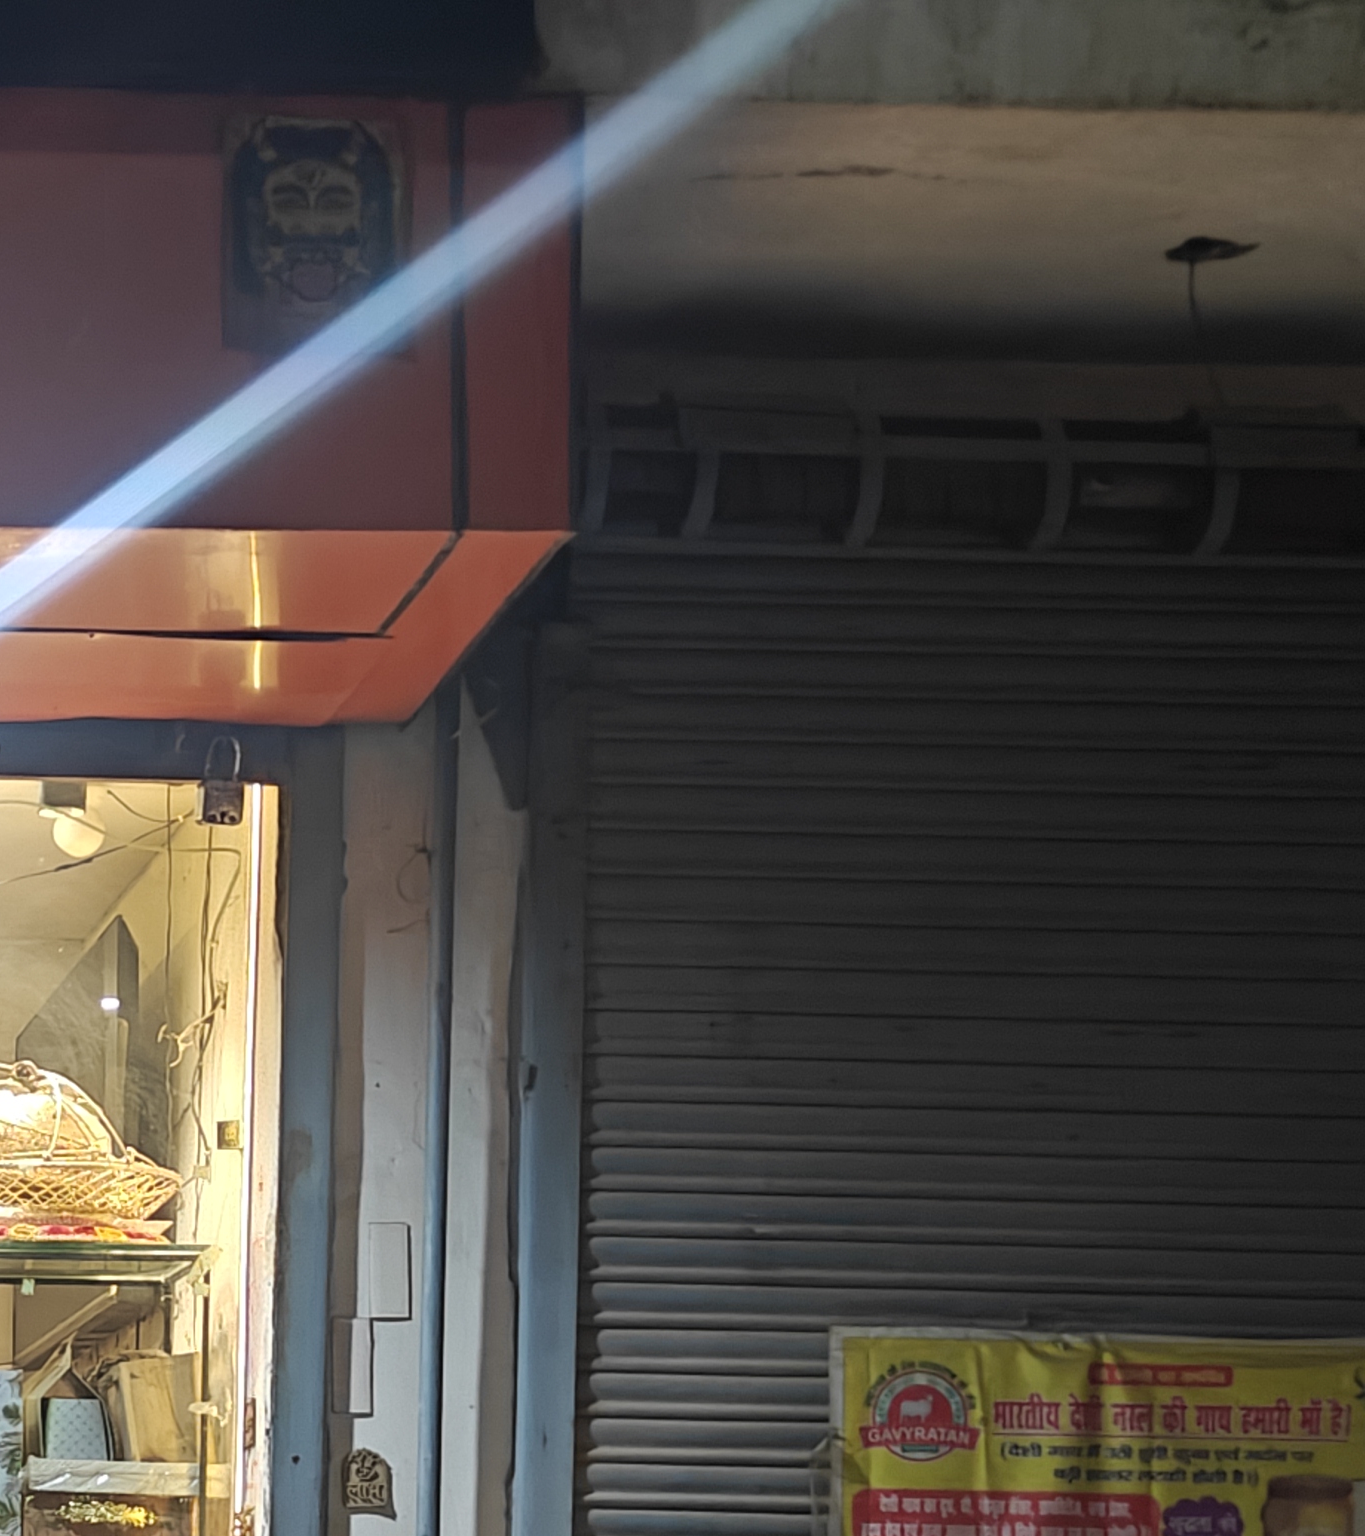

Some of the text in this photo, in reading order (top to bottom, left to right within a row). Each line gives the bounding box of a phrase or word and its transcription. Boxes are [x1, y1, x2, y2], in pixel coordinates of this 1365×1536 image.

[1161, 1396, 1186, 1433] की
[1195, 1404, 1233, 1434] गाय
[1241, 1398, 1291, 1434] हमारी
[869, 1426, 969, 1444] GAVYRATAN
